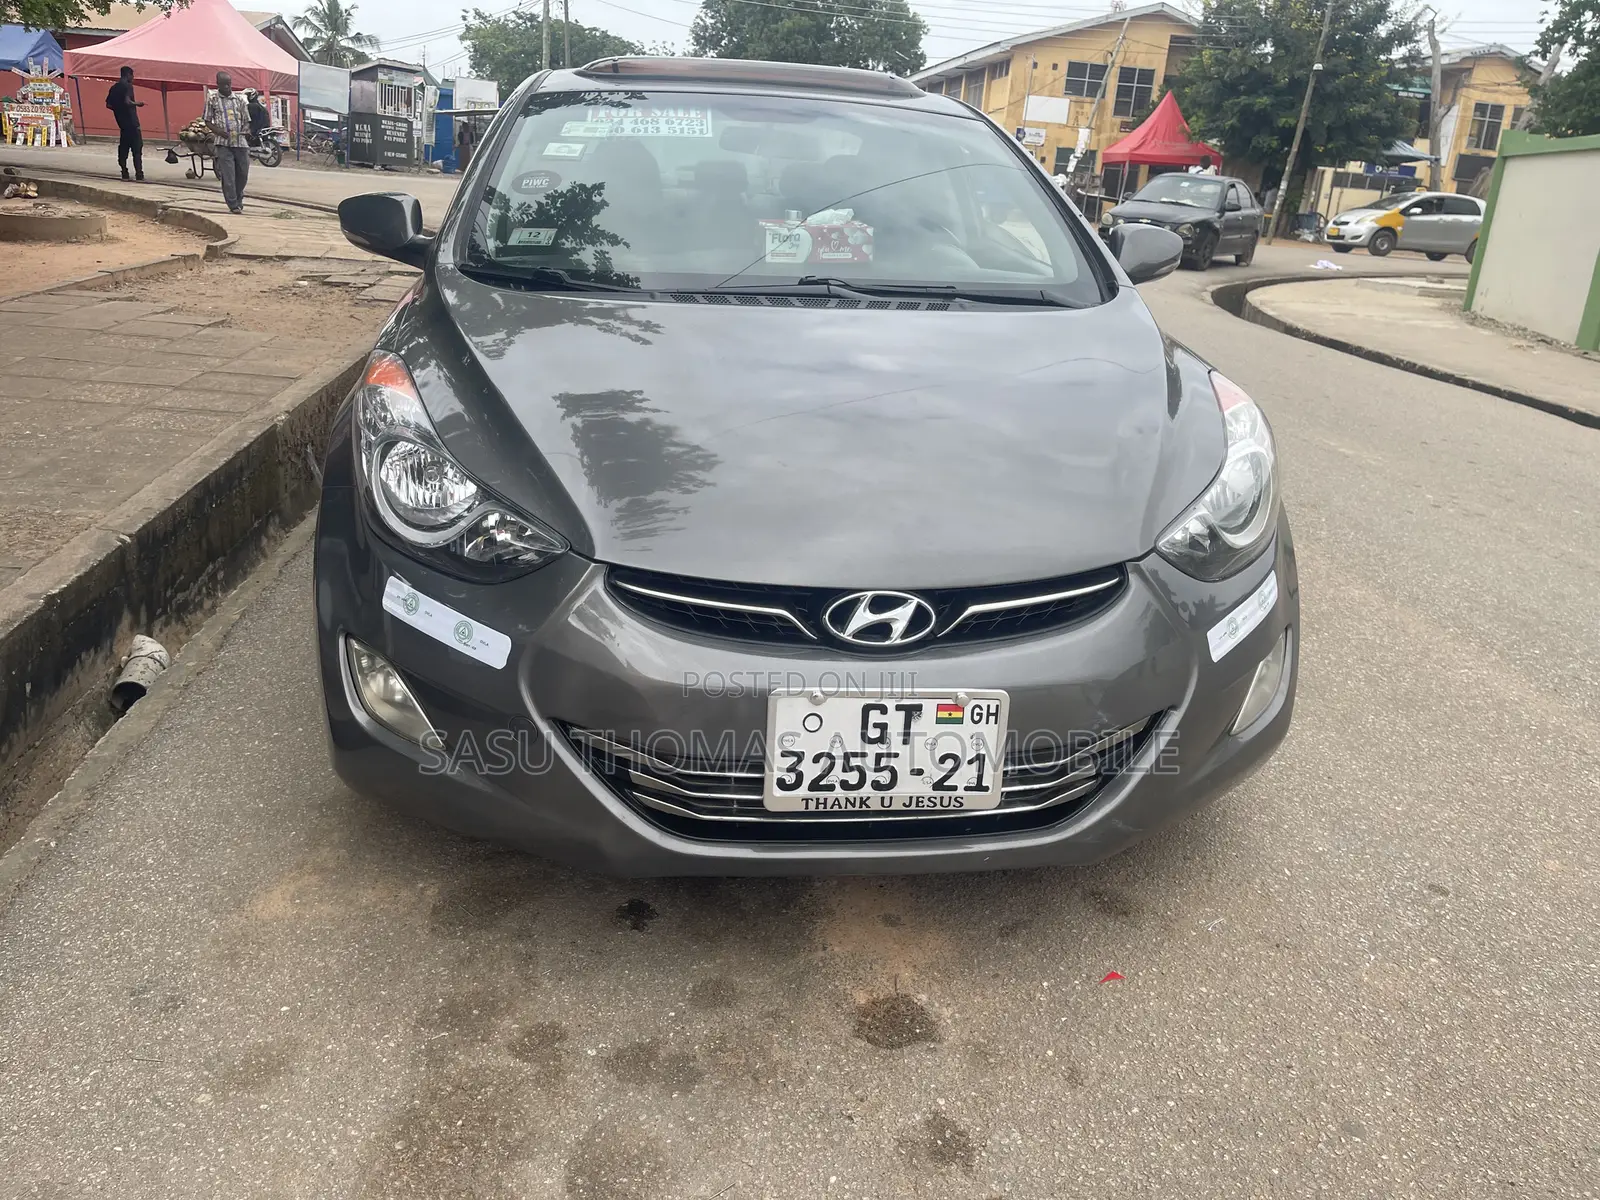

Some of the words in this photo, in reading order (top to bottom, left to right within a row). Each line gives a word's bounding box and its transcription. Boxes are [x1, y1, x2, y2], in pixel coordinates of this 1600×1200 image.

[597, 107, 642, 118] FOR
[651, 107, 701, 118] SALE
[772, 233, 801, 244] Flora
[970, 704, 999, 725] GH
[860, 703, 923, 745] GT
[801, 796, 872, 811] THANK
[880, 796, 894, 809] U
[902, 796, 964, 809] JESUS
